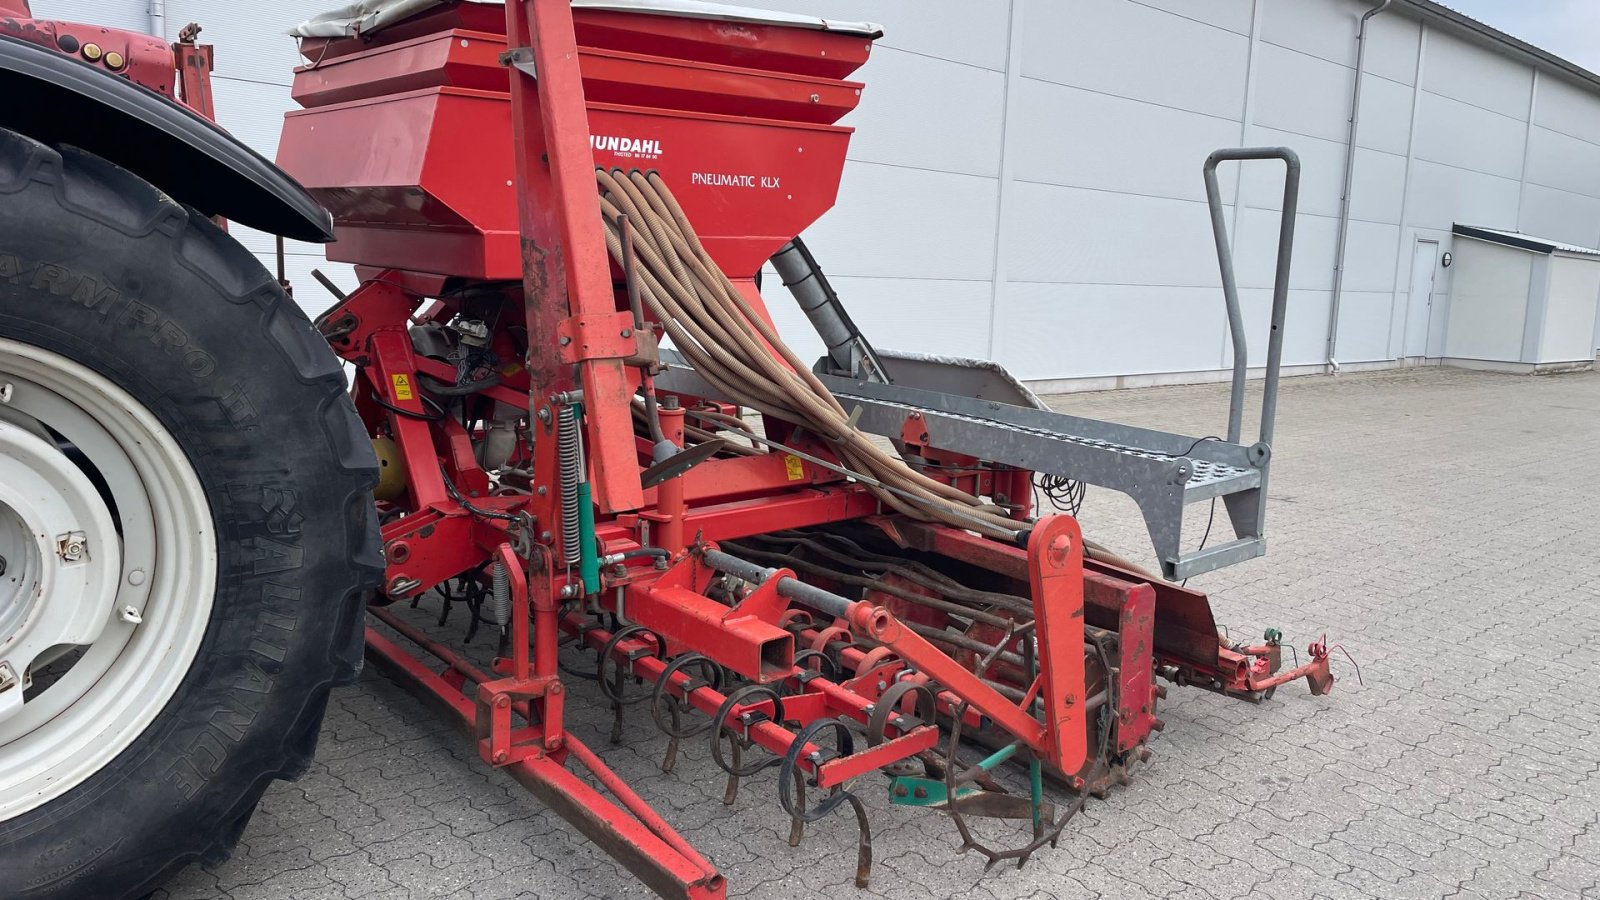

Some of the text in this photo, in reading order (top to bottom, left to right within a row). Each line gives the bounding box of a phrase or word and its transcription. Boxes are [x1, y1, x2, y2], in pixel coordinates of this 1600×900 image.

[692, 172, 780, 189] PNEUMATIC KLX
[164, 536, 305, 802] ALLIANCE
